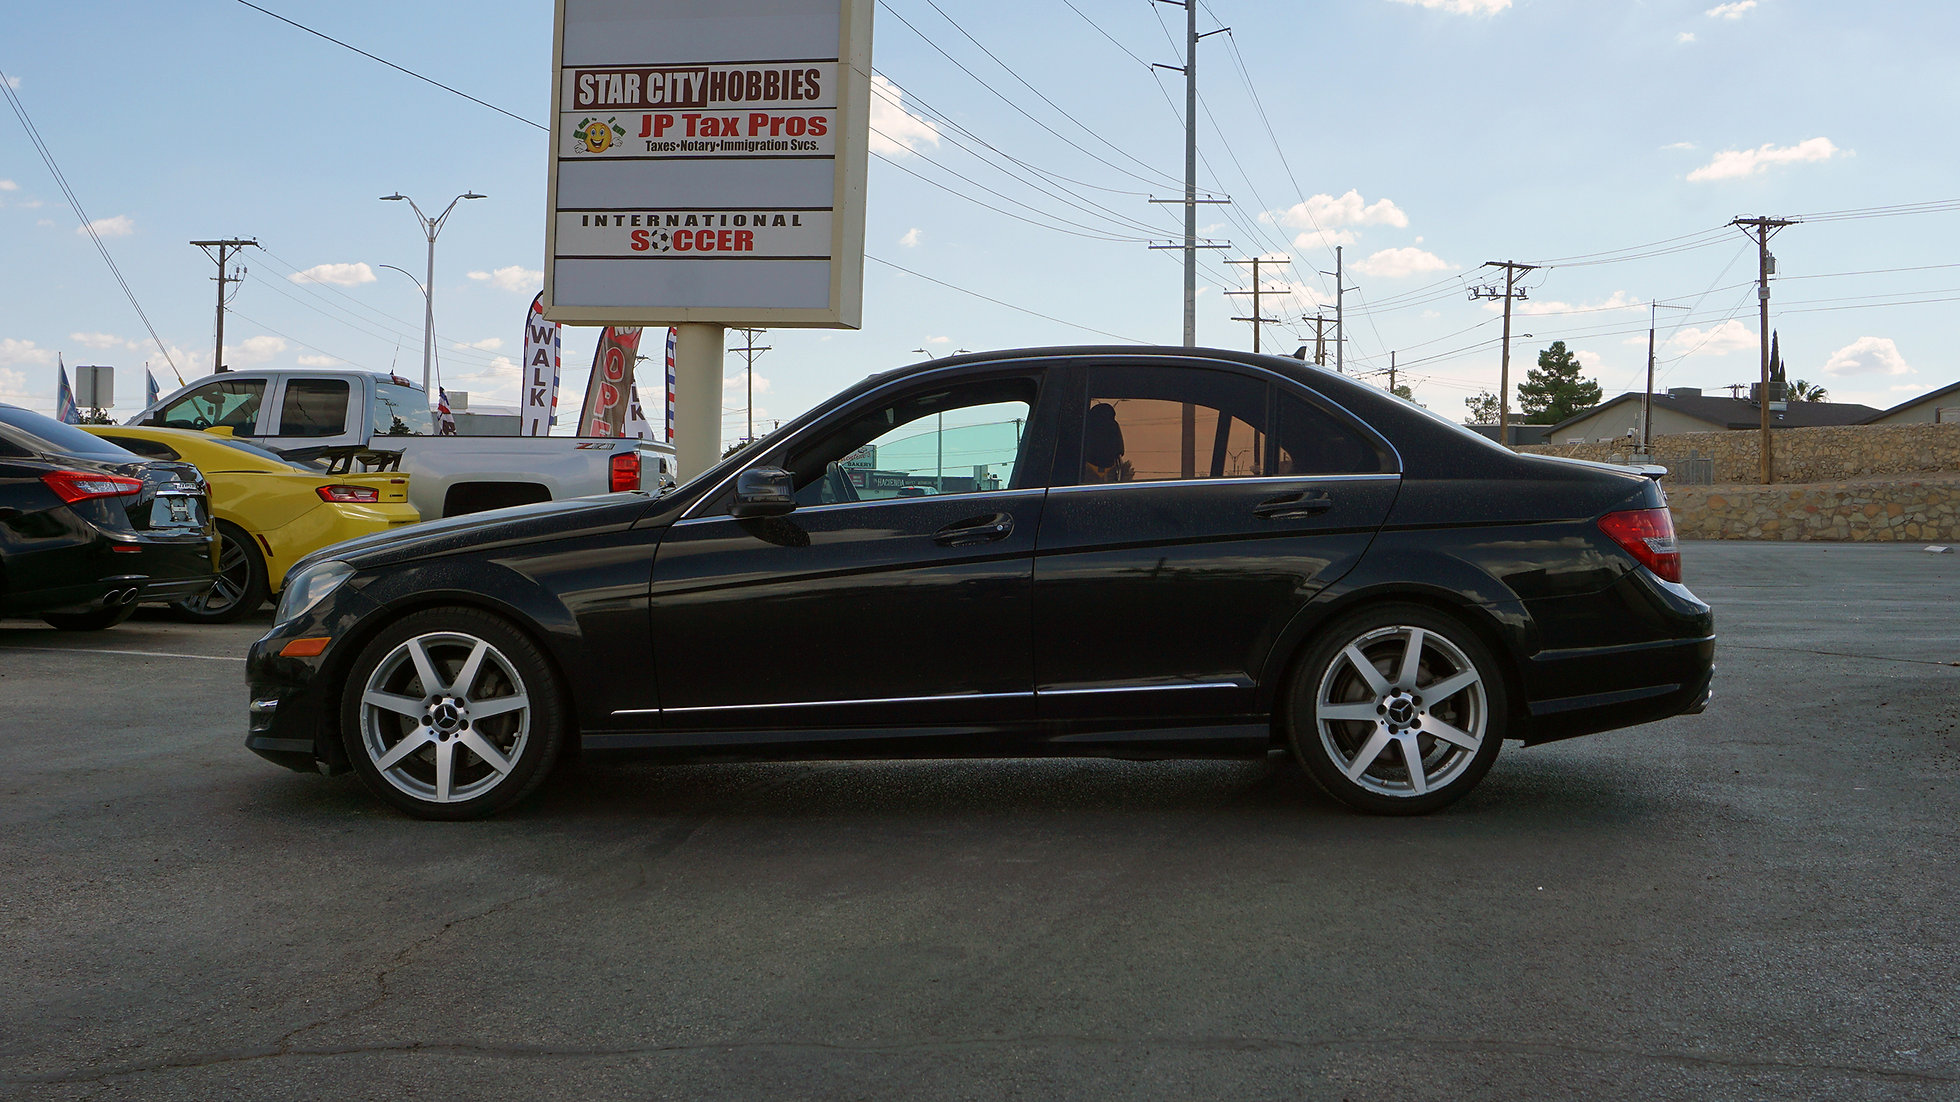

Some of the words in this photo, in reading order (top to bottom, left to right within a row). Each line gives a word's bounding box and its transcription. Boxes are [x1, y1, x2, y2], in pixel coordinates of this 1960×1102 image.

[579, 73, 640, 105] STAR
[646, 72, 704, 104] CITY
[709, 68, 821, 102] HOBBIES
[638, 114, 674, 138] JP
[682, 113, 740, 137] Tax
[748, 113, 828, 136] Pros
[790, 138, 819, 151] Svcs.
[582, 214, 803, 227] INTERNATIONAL
[530, 324, 554, 408] WALK
